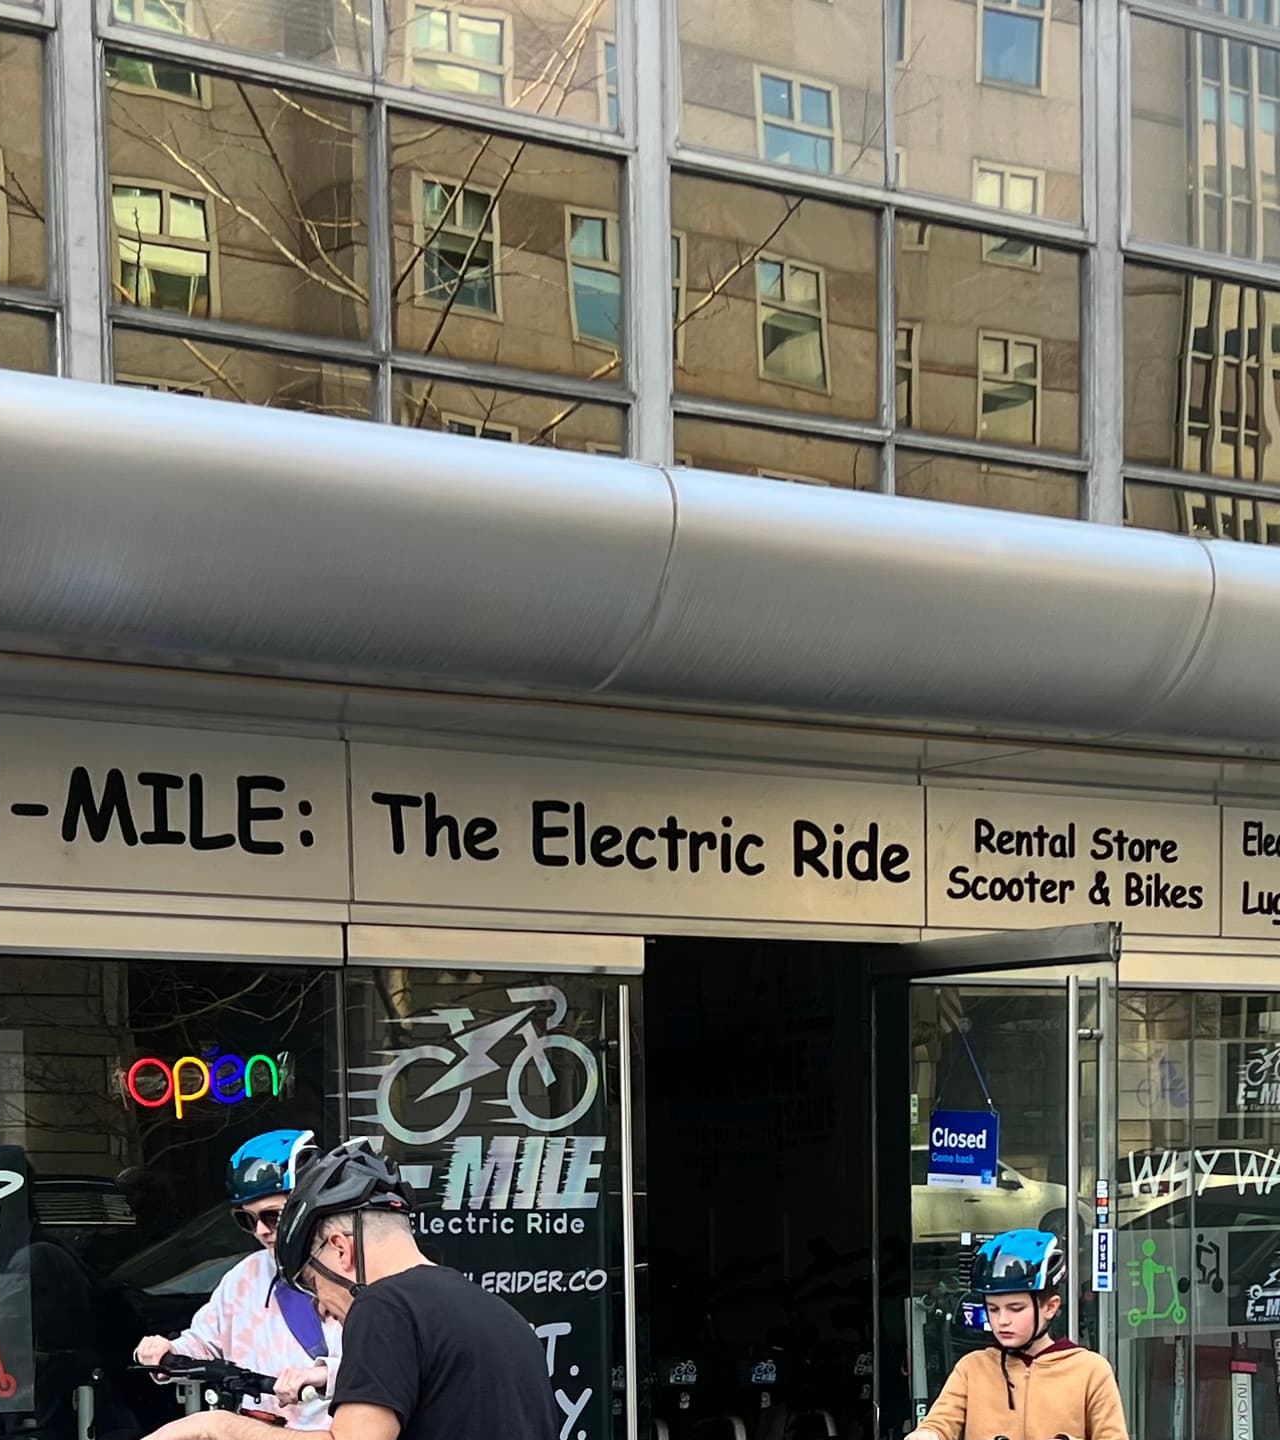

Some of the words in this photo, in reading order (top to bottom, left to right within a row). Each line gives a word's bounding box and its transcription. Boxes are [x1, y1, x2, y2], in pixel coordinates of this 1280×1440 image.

[371, 791, 500, 861] The
[531, 800, 766, 877] Electric
[793, 819, 911, 883] Ride
[974, 818, 1076, 861] Rental
[1090, 826, 1179, 864] Store
[946, 866, 1075, 905] Scooter
[1088, 870, 1110, 907] &
[1124, 872, 1204, 910] Bikes
[127, 1053, 280, 1120] open
[931, 1127, 988, 1149] Closed
[931, 1152, 954, 1164] Come
[955, 1153, 974, 1165] back
[350, 1136, 606, 1210] -MILE
[1128, 1149, 1221, 1198] WHY
[528, 1211, 585, 1235] Ride
[1099, 1234, 1108, 1271] PUSH
